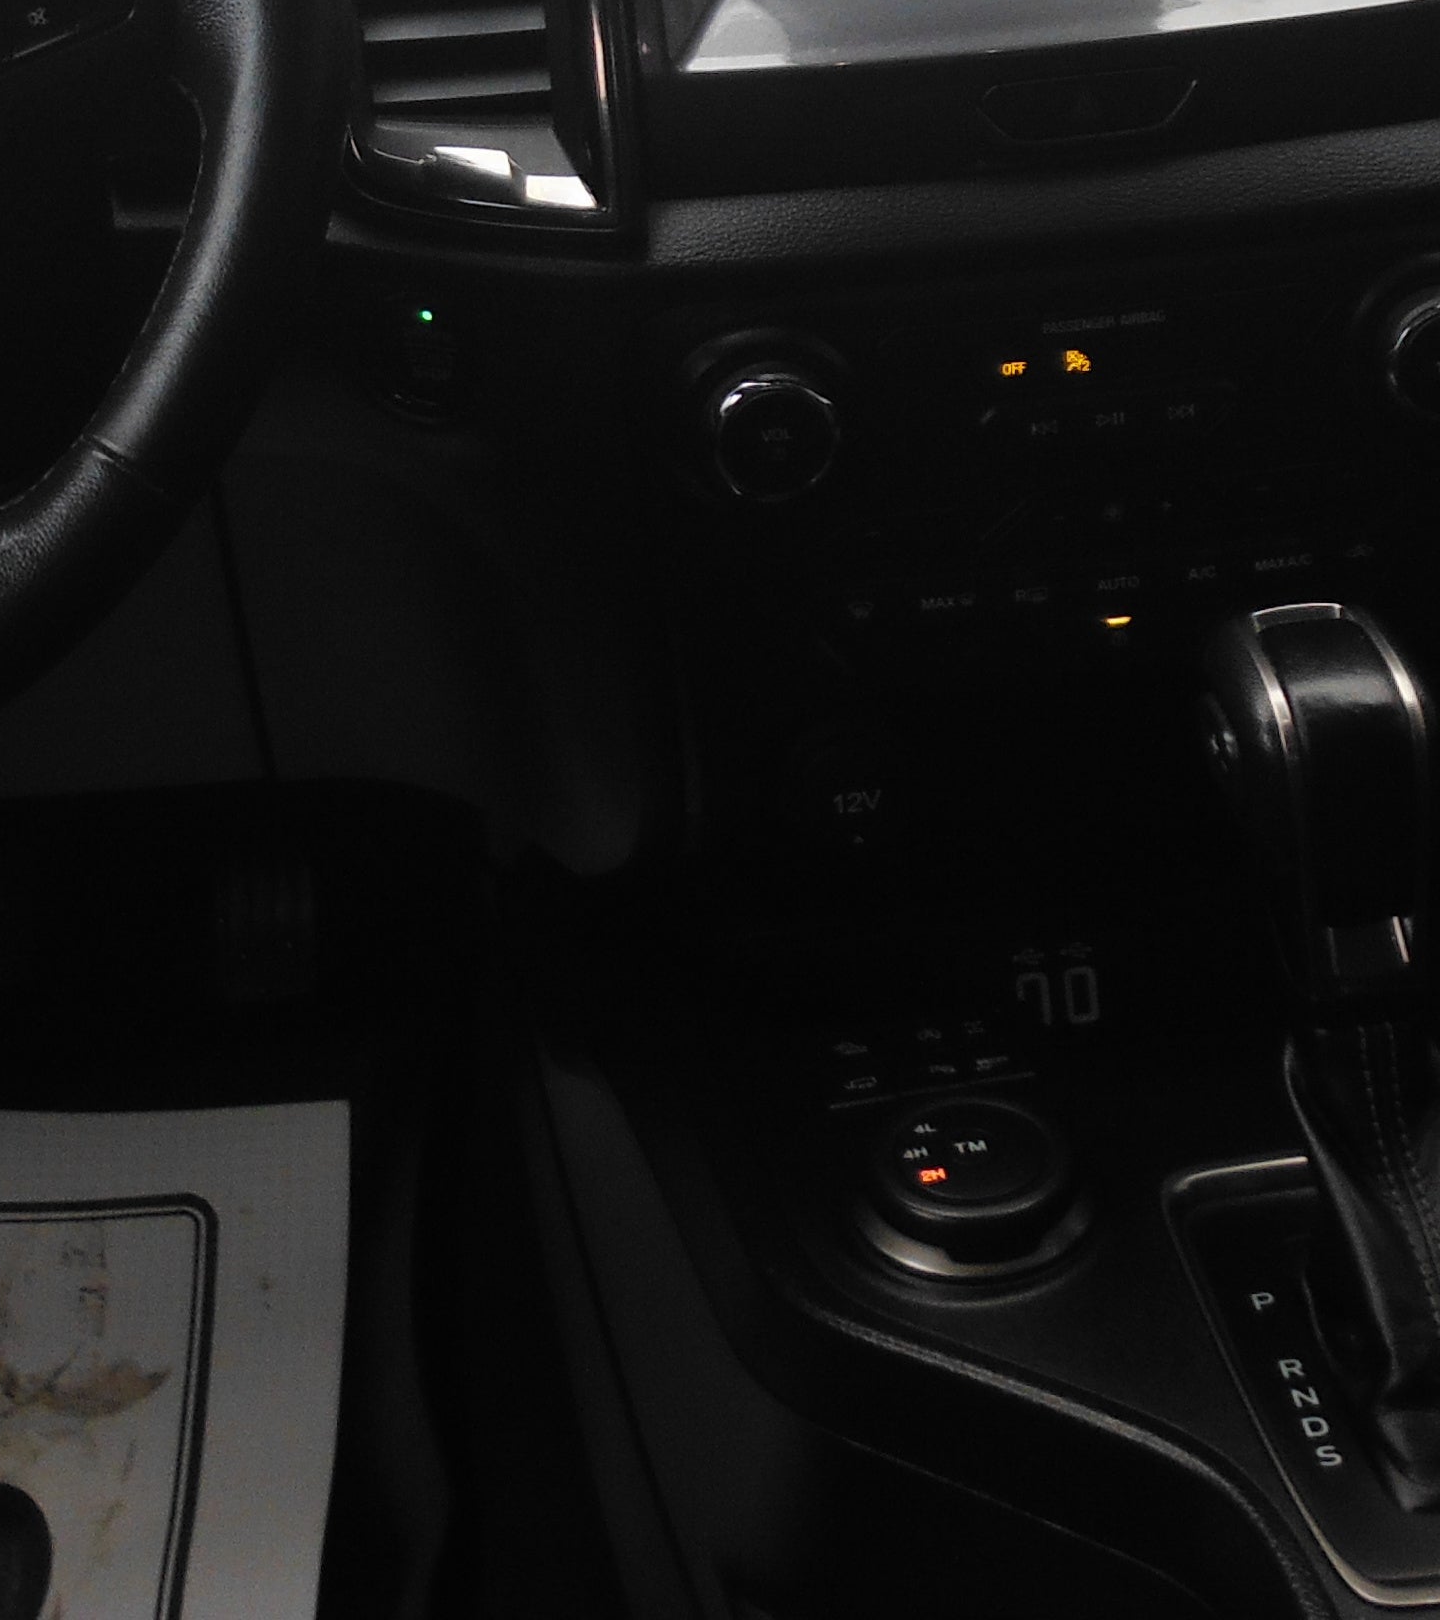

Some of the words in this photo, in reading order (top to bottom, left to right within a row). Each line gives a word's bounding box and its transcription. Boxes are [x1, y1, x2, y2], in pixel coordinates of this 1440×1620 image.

[1001, 361, 1028, 376] OFF
[760, 427, 793, 443] VOL
[1189, 565, 1216, 581] A/C
[1098, 575, 1140, 591] AUTO
[920, 596, 956, 611] MAX
[833, 788, 882, 815] 12V
[913, 1123, 937, 1134] 4L
[903, 1146, 929, 1159] 4H
[954, 1139, 988, 1155] TM
[920, 1167, 947, 1182] 2H
[1251, 1290, 1276, 1312] P
[1279, 1358, 1306, 1380] R
[1292, 1388, 1320, 1409] N
[1303, 1415, 1328, 1437] D
[1315, 1444, 1344, 1467] S
